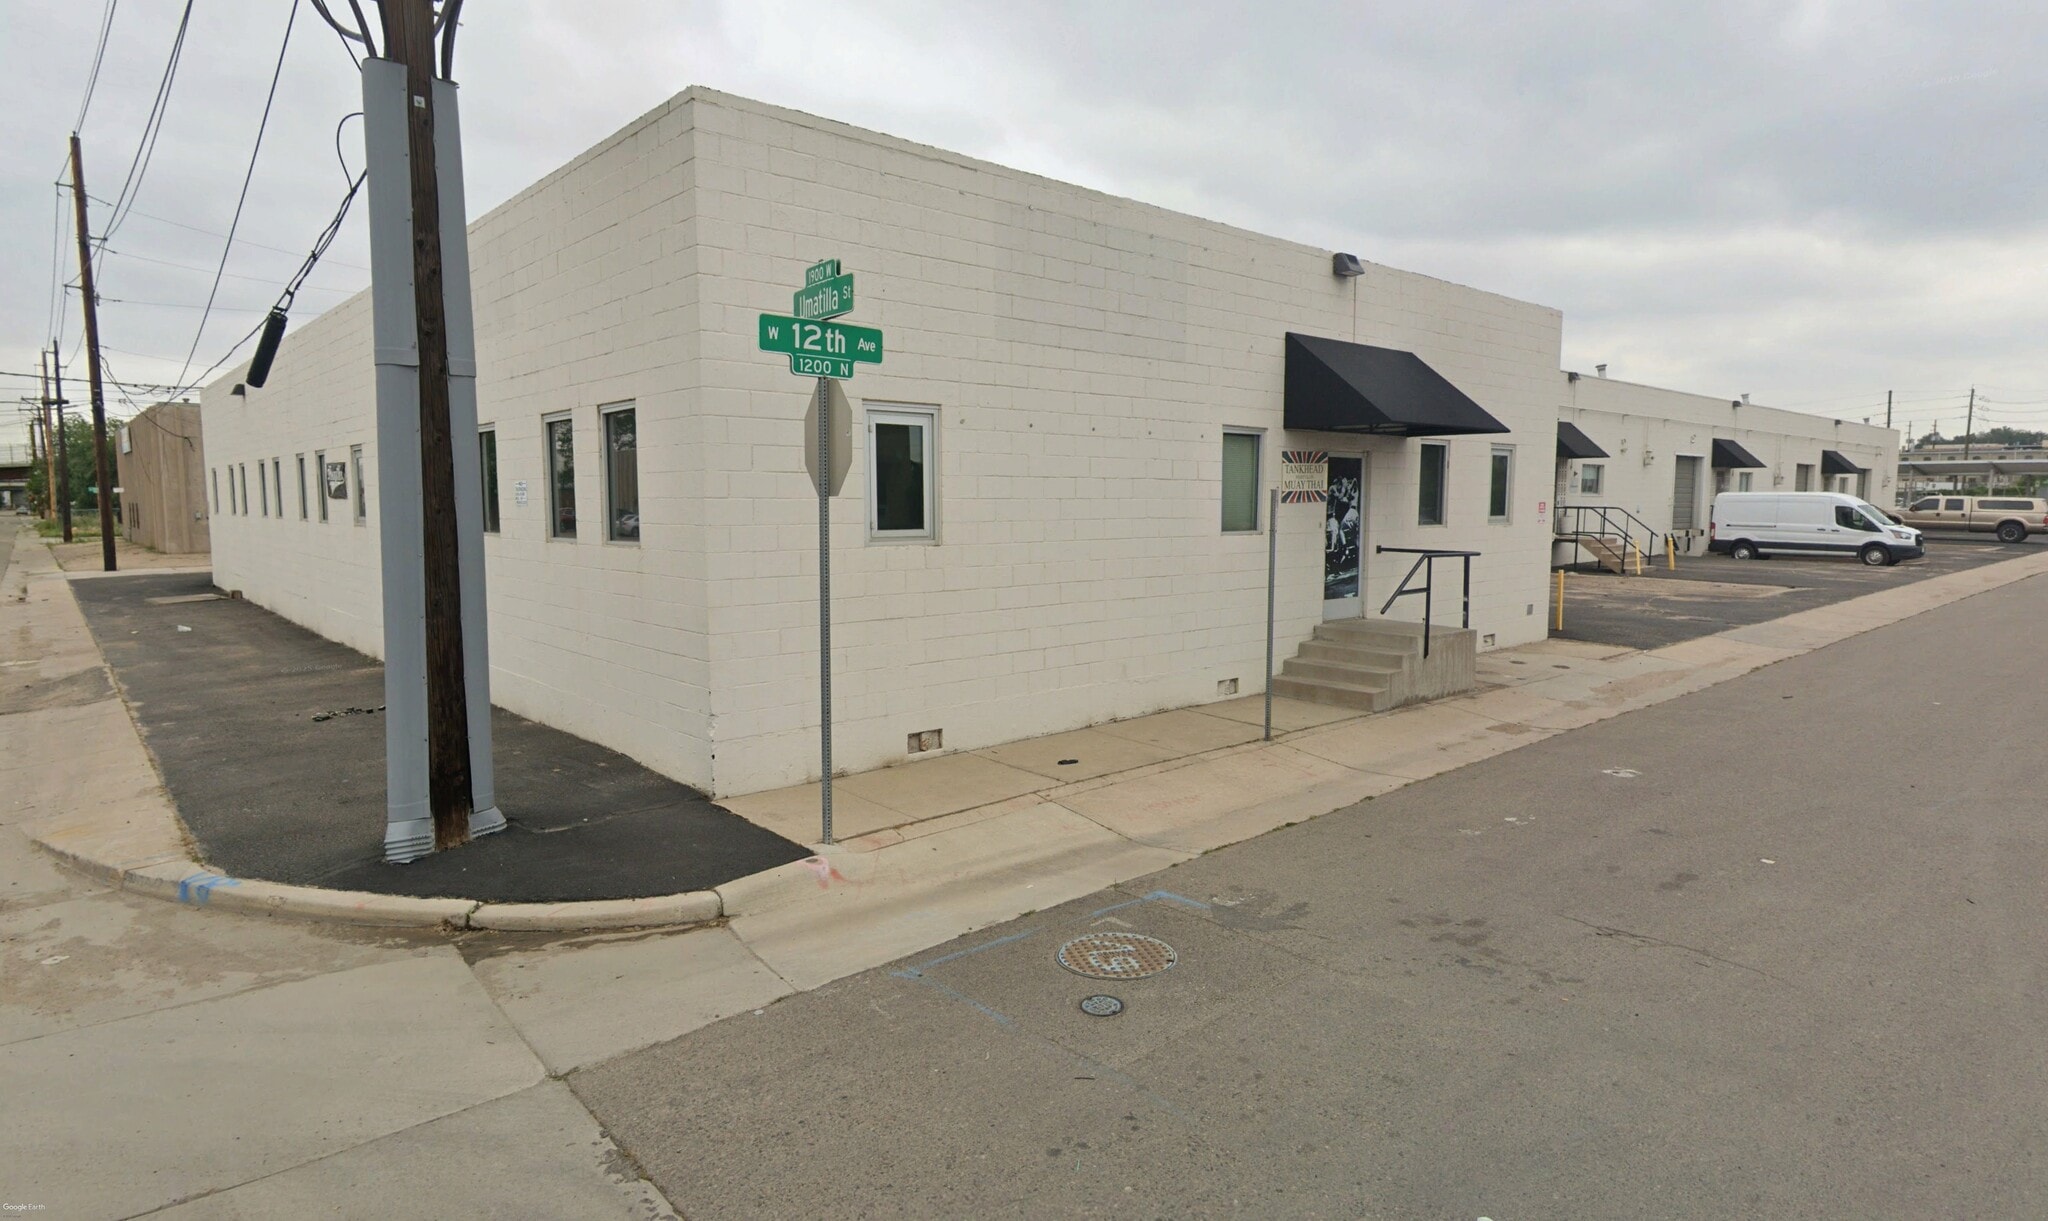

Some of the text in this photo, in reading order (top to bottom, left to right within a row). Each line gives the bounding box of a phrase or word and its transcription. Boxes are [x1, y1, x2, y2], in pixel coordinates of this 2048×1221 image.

[808, 262, 832, 284] 1900 W
[799, 285, 851, 319] Umatilla St
[768, 322, 876, 354] W 12th Ave
[799, 358, 849, 376] 1200 N
[1285, 464, 1324, 474] TANKHEAD
[1284, 480, 1324, 490] MUAY THAI
